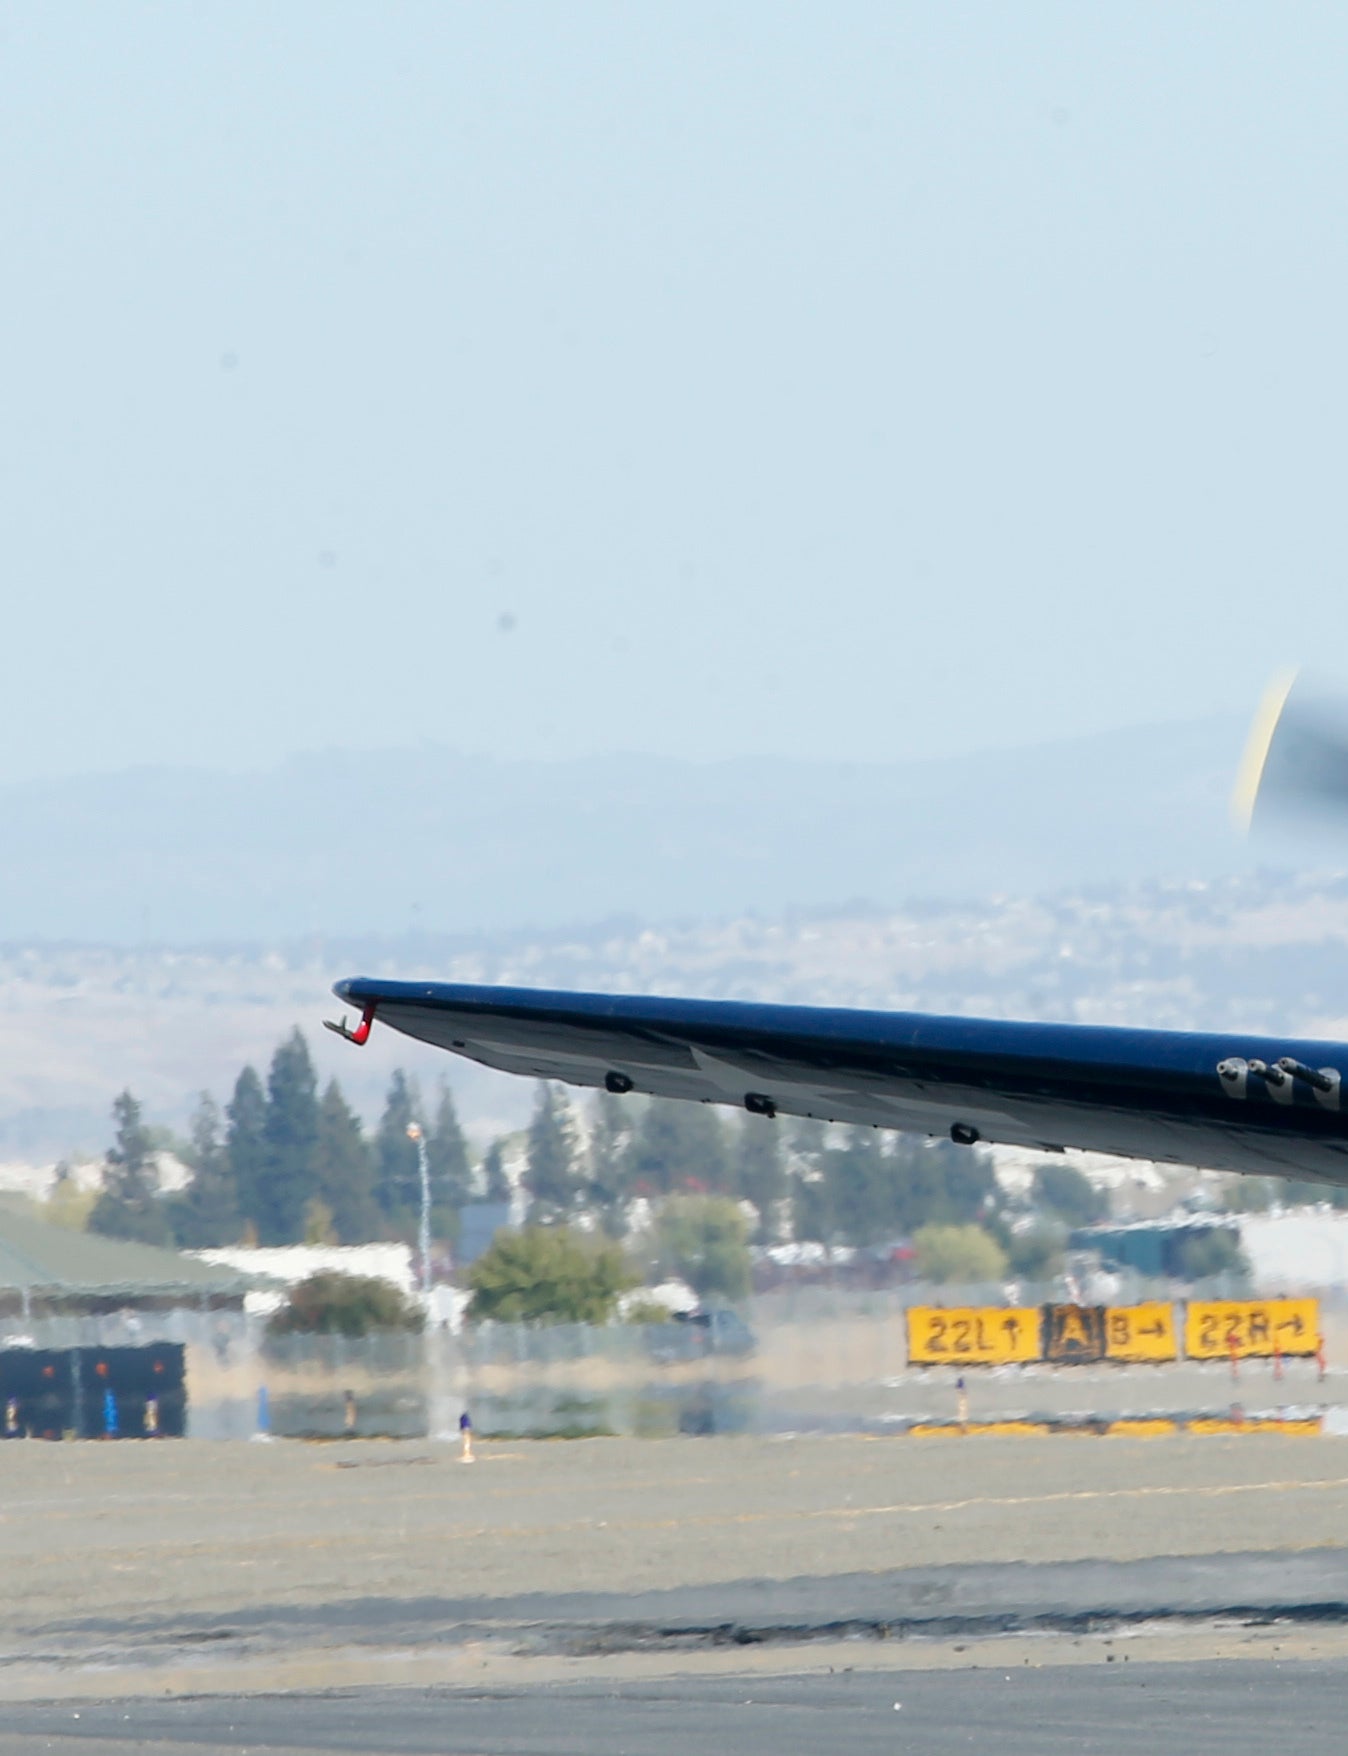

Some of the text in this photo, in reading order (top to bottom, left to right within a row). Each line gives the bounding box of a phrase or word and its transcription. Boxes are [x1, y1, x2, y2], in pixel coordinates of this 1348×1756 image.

[925, 1316, 994, 1352] 22L
[1059, 1304, 1088, 1346] A
[1109, 1314, 1131, 1346] B
